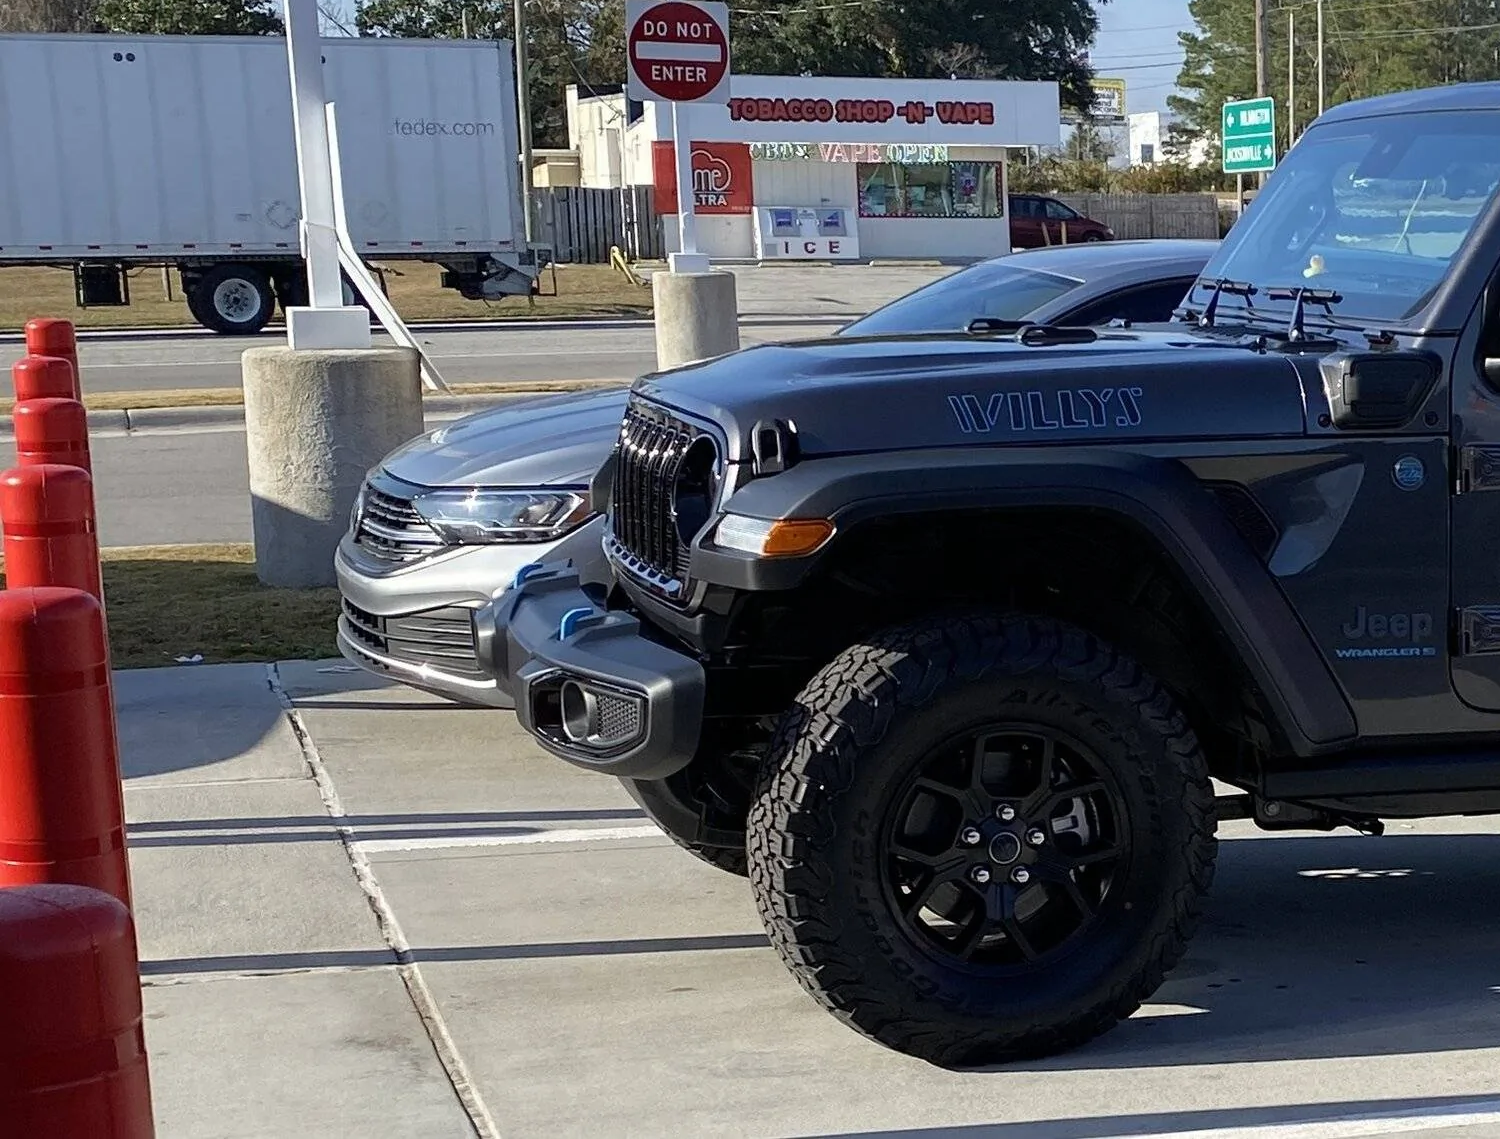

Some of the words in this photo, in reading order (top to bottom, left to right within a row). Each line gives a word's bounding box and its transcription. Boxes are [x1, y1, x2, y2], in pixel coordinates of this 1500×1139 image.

[643, 20, 668, 37] DO
[676, 21, 713, 39] NOT
[651, 65, 707, 83] ENTER
[728, 98, 834, 122] TOBACCO
[835, 99, 895, 123] SHOP
[935, 101, 994, 124] VAPE
[750, 143, 793, 162] CBD
[818, 143, 882, 162] VAPE
[886, 144, 949, 163] OPEN
[693, 194, 728, 206] LTRA
[784, 241, 840, 254] ICE
[948, 387, 1143, 433] WILLYS
[1342, 605, 1433, 642] Jeep
[1336, 647, 1421, 658] WRANGLER
